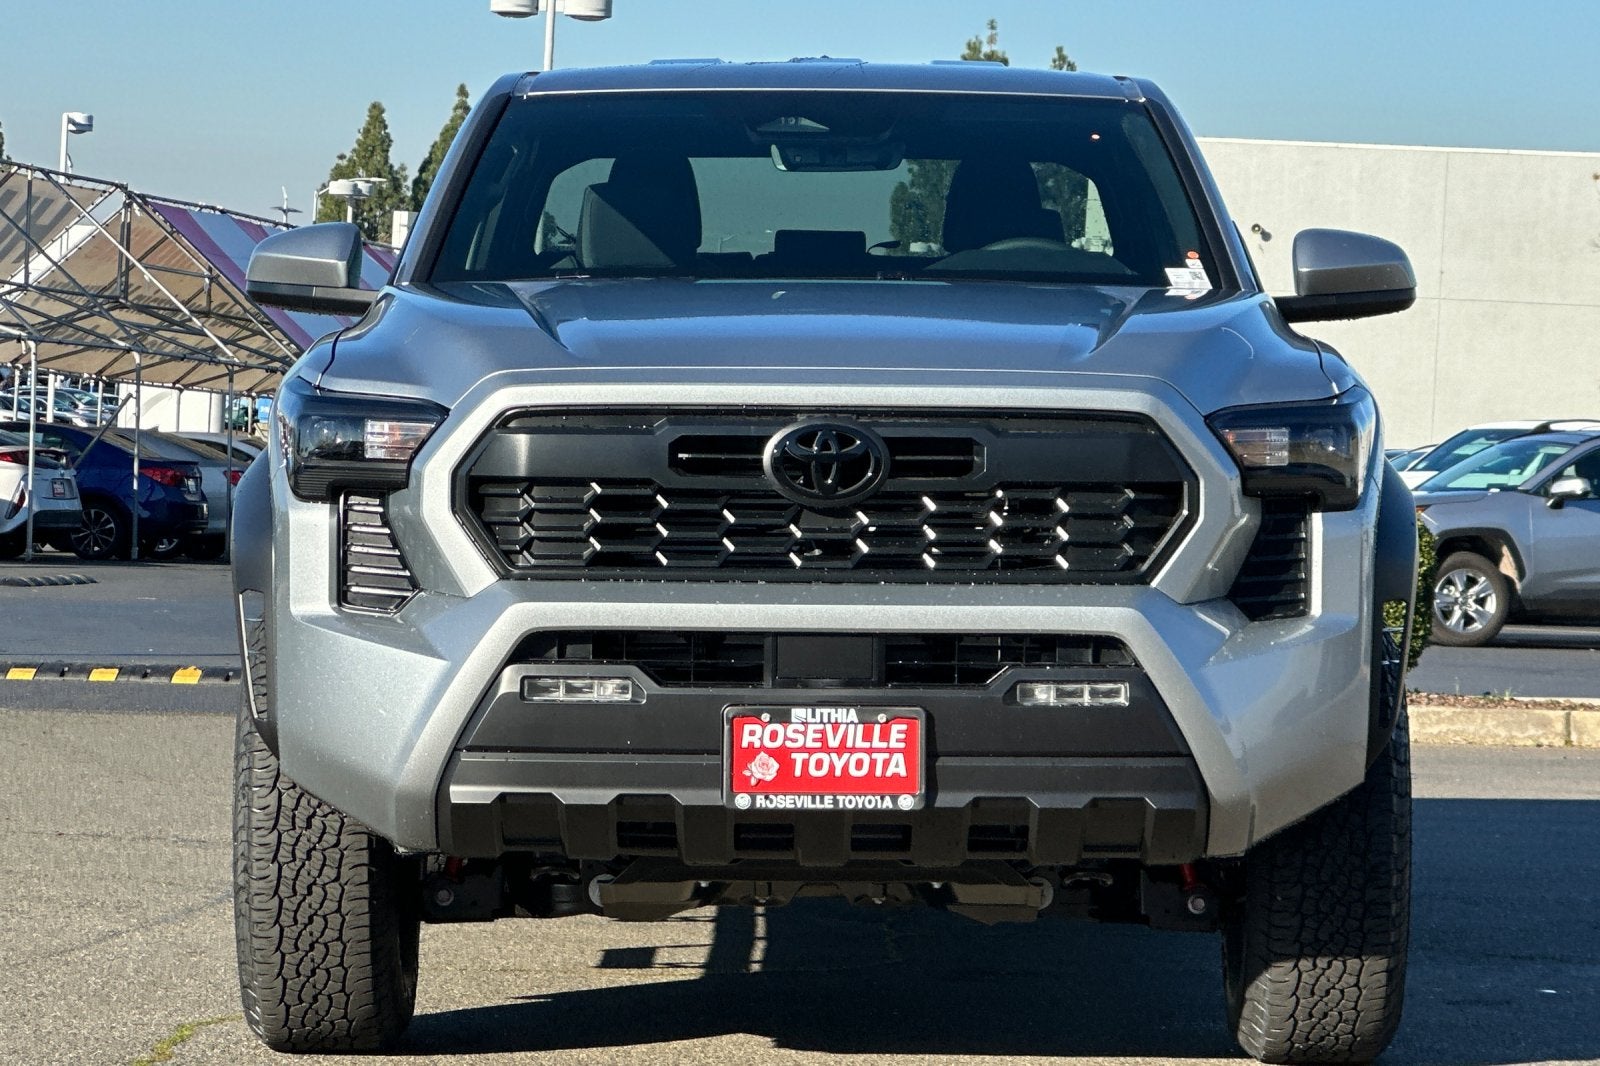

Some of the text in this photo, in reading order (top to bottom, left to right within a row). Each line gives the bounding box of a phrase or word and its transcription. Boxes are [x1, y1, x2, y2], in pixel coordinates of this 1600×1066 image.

[806, 708, 859, 723] LITHIA
[741, 723, 908, 749] ROSEVILLE
[790, 752, 908, 777] TOYOTA
[756, 795, 893, 809] ROSEVILLE TOYOTA
